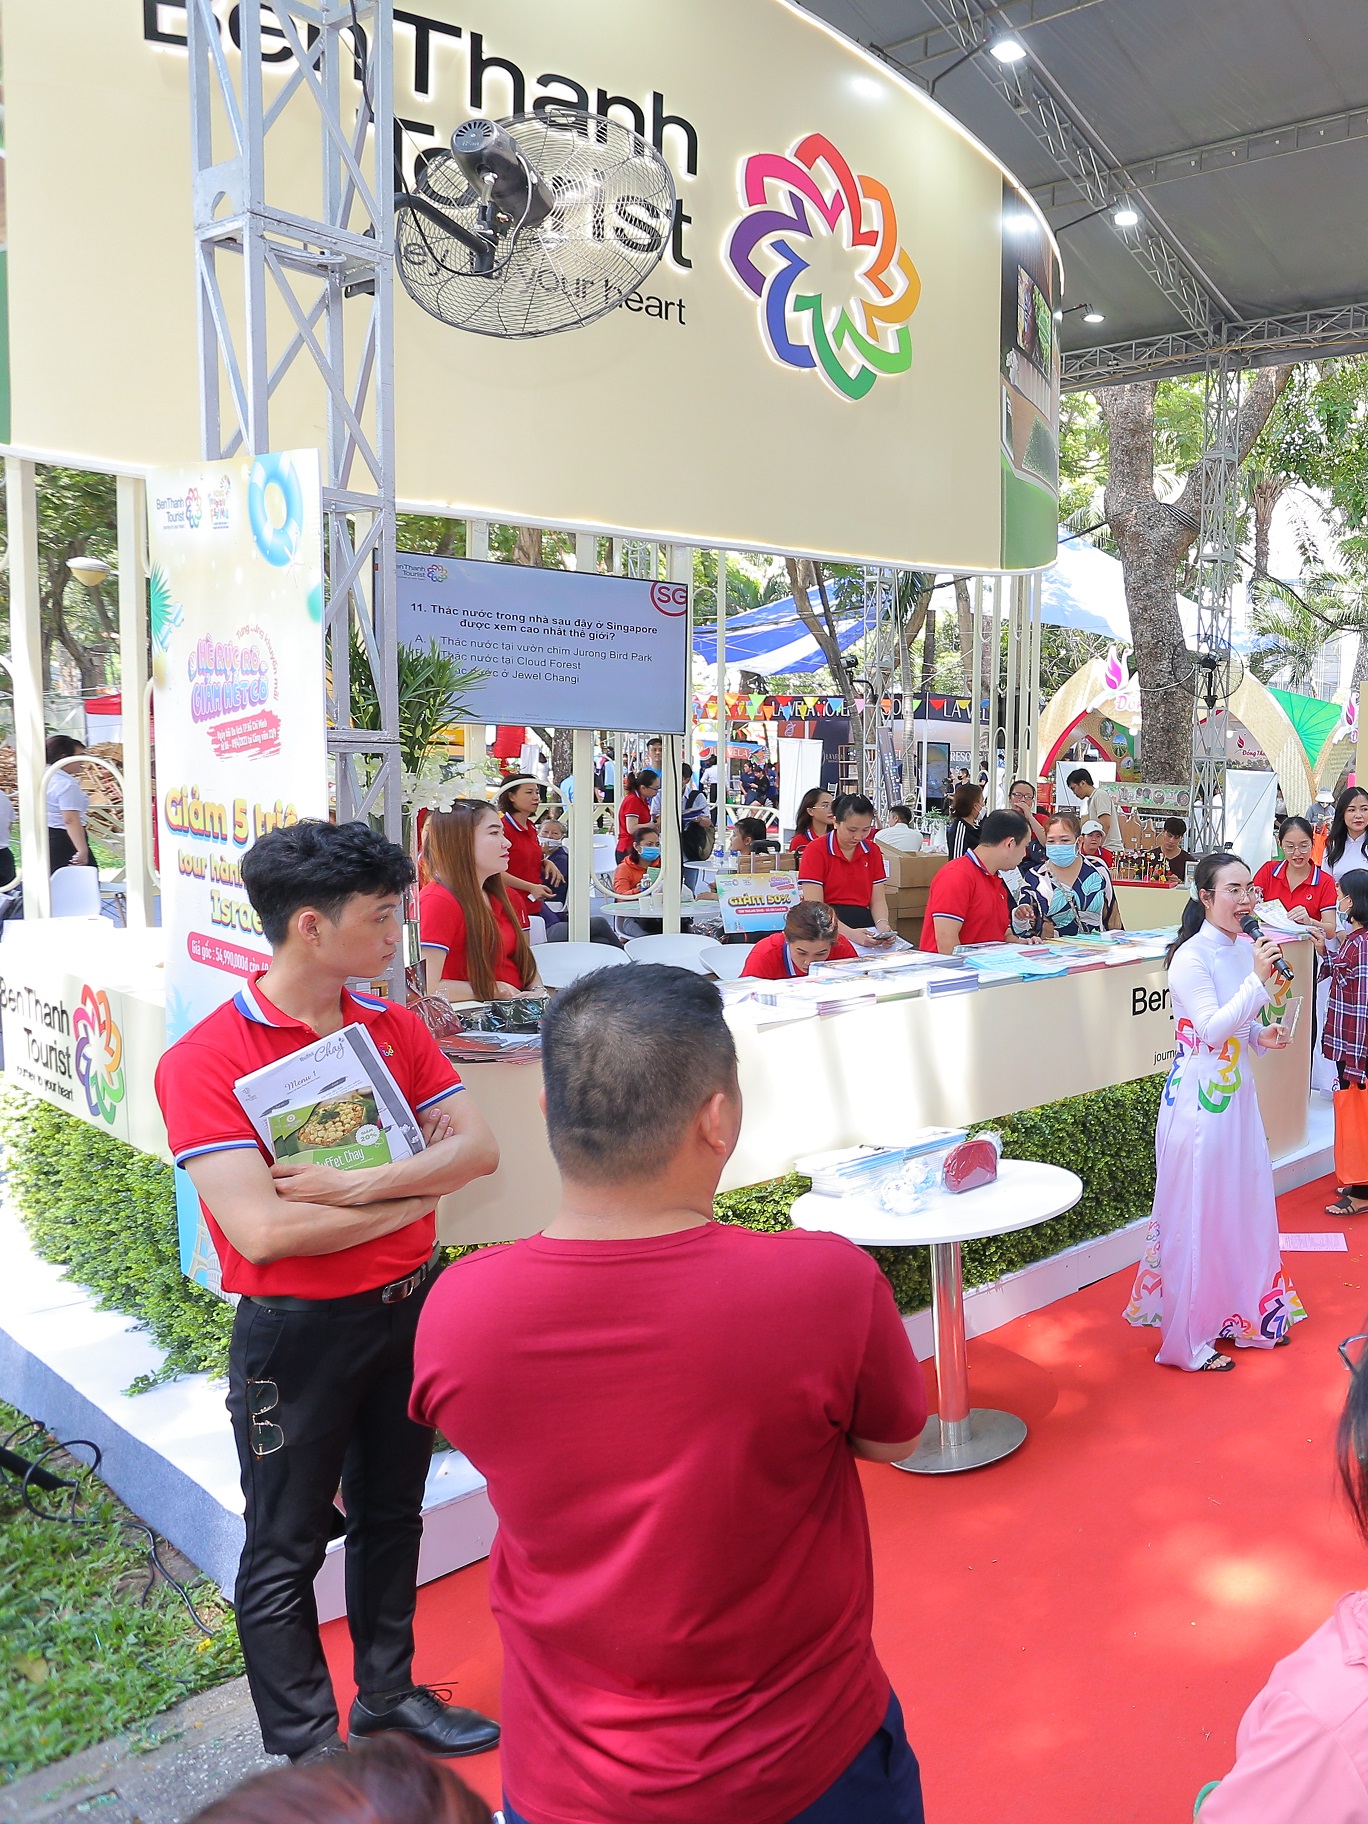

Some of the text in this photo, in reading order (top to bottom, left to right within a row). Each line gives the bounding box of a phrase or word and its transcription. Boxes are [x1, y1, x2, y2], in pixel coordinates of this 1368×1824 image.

[604, 278, 687, 326] heart
[411, 603, 427, 612] 11.
[430, 604, 458, 616] Thác
[462, 609, 493, 619] nước
[496, 611, 526, 624] trong
[528, 612, 549, 625] nhà
[552, 616, 571, 627] sau
[606, 621, 658, 635] Singapore
[460, 619, 617, 642] được xem cao nhất thế giới?
[415, 634, 653, 662] A. Thác nước tại vườn chim Jurong Bird Park
[470, 653, 499, 664] nước
[501, 655, 514, 666] tại
[517, 656, 547, 669] Cloud
[549, 658, 582, 670] Forest
[512, 668, 542, 681] Jewel
[544, 671, 580, 685] Changi
[165, 784, 228, 845] Giảm
[232, 798, 249, 849] 5
[178, 849, 208, 880] tour
[728, 893, 792, 907] GIẢM 50%
[210, 889, 265, 936] Israe
[191, 940, 201, 954] Giá
[201, 940, 212, 960] gốc
[23, 1027, 73, 1080] Tourist
[314, 1037, 345, 1063] Chay
[285, 1074, 312, 1091] Menu
[360, 1132, 378, 1142] 20%
[343, 1148, 365, 1163] Chay
